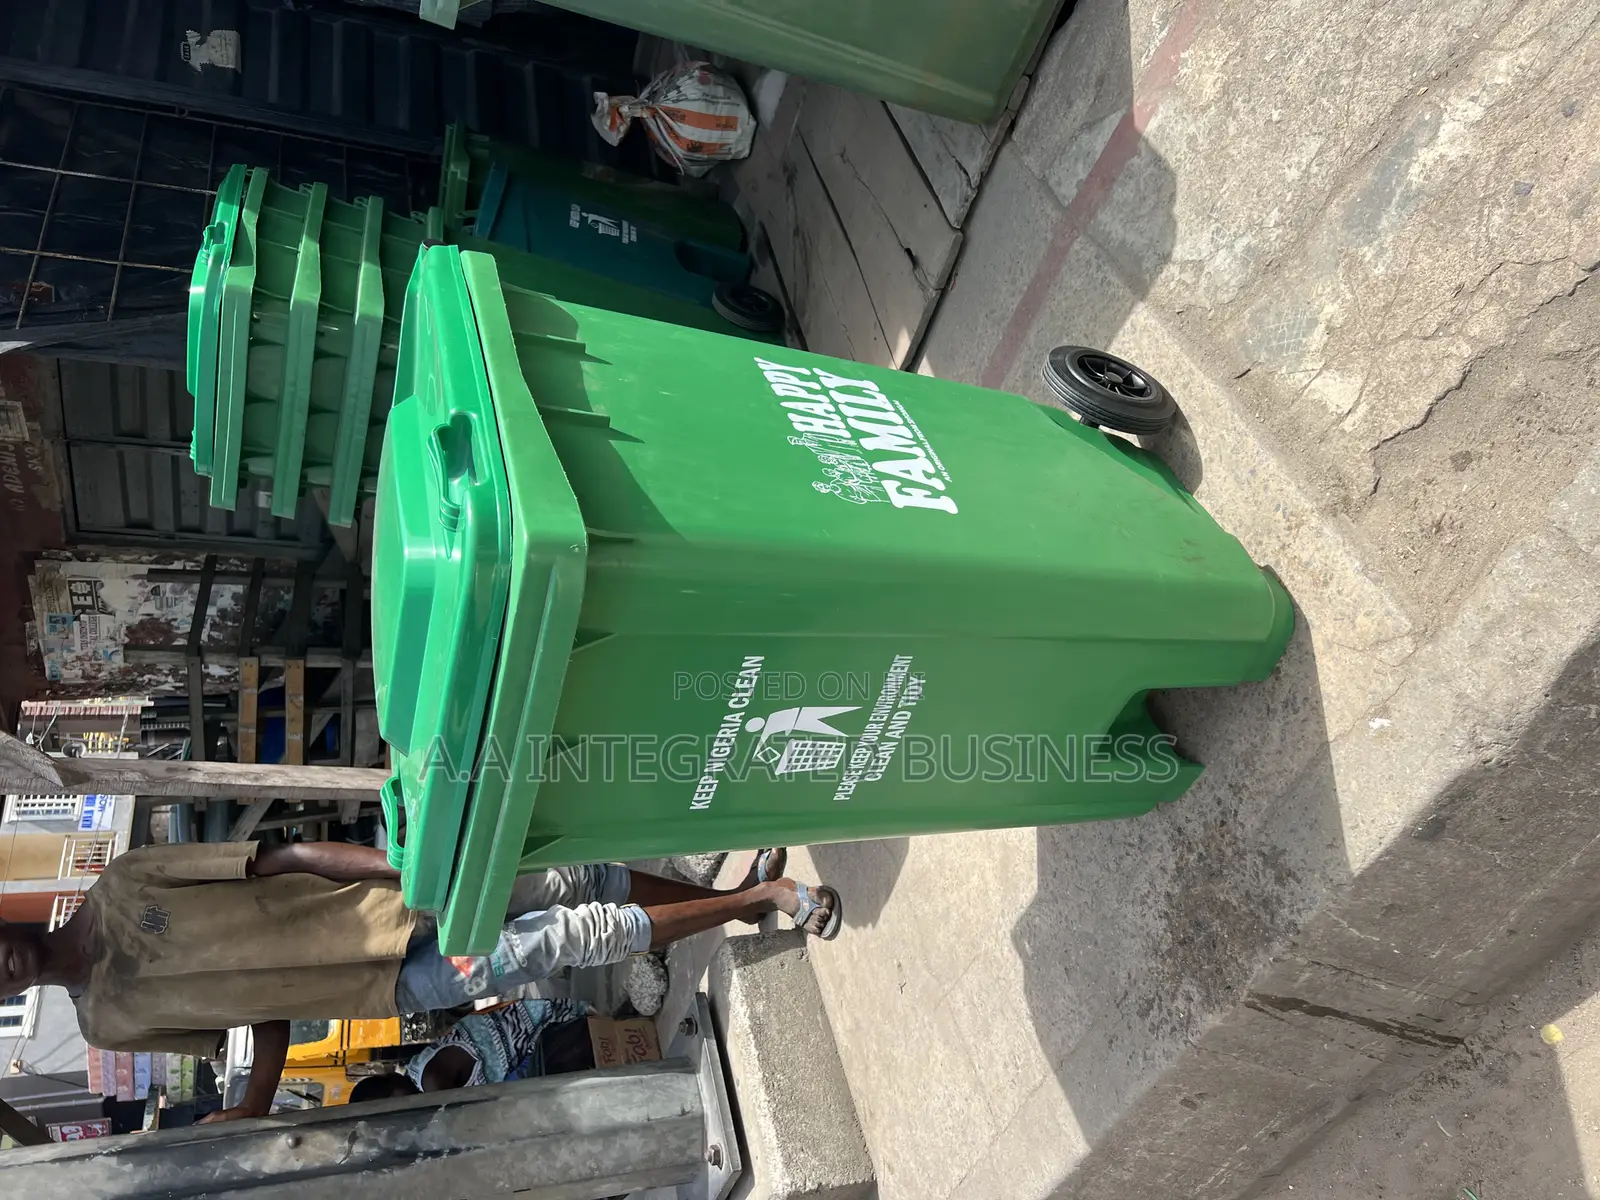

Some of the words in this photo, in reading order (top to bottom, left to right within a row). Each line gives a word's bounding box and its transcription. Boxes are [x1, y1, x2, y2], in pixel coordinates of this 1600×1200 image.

[753, 357, 851, 438] HAPPY
[813, 367, 959, 514] FAMILY
[727, 655, 765, 709] CLEAN
[868, 654, 914, 722] ENVIRONMENT
[897, 676, 927, 709] TIDY
[703, 711, 746, 773] NIGERIA
[856, 722, 885, 747] YOUR
[884, 710, 912, 739] AND
[846, 747, 873, 769] KEEP
[864, 741, 899, 782] CLEAN
[689, 775, 719, 810] KEEP
[832, 770, 863, 801] PLEASE
